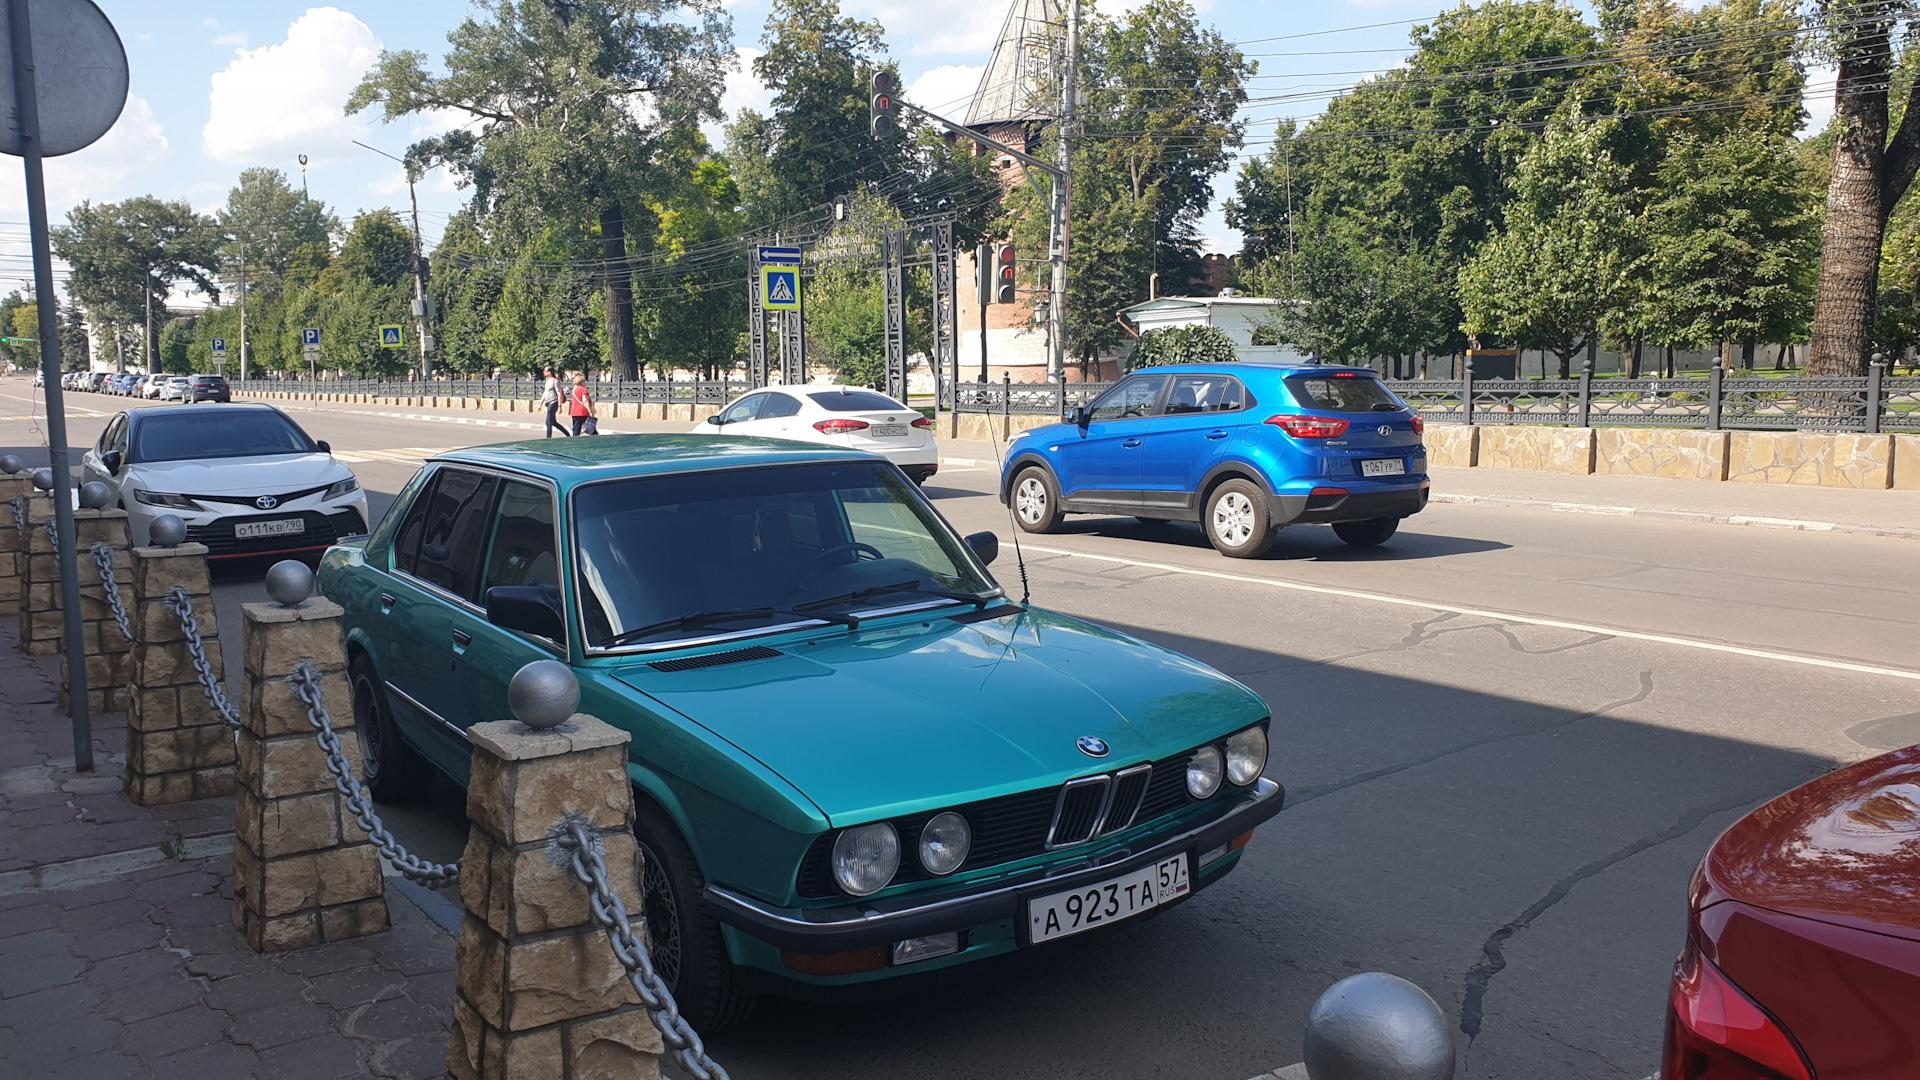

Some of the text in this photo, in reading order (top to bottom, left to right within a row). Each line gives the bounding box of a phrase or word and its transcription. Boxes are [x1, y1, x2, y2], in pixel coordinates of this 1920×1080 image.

[306, 330, 315, 343] P
[215, 340, 222, 349] P
[1159, 859, 1180, 888] 57
[1159, 887, 1176, 899] RUS
